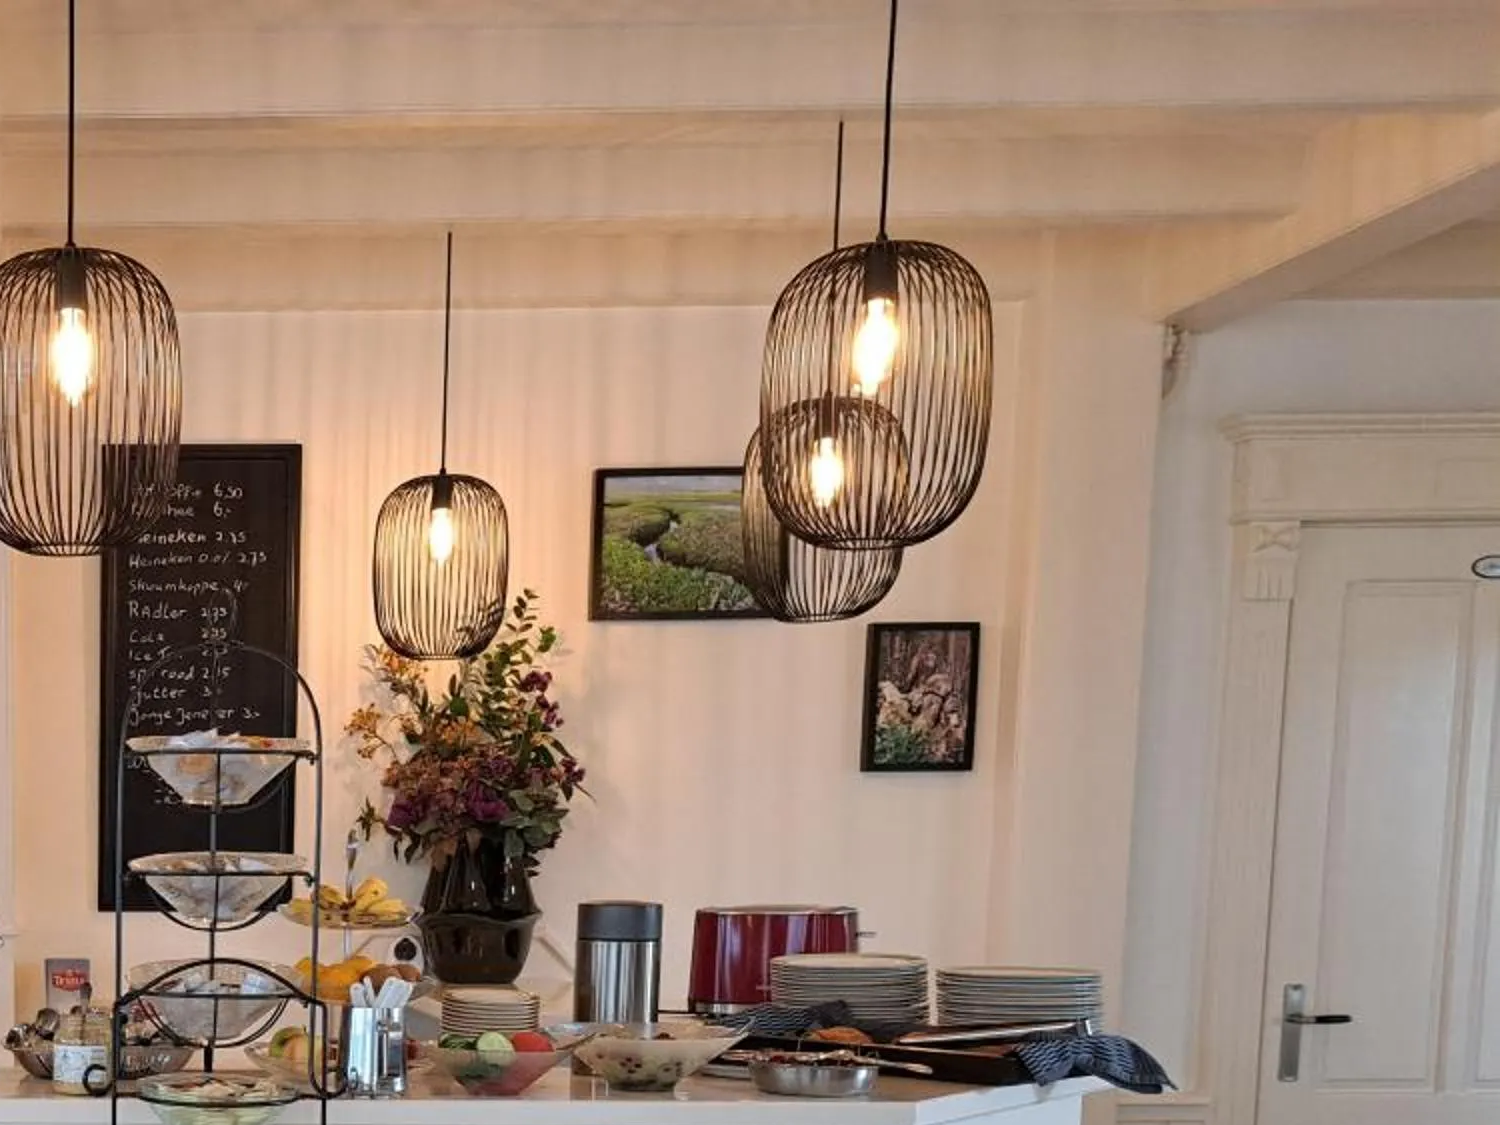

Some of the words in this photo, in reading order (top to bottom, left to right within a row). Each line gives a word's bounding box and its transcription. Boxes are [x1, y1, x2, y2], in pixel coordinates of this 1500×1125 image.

[135, 528, 208, 545] eineken
[128, 551, 194, 569] Heineken
[129, 628, 165, 644] Cola
[128, 667, 155, 685] sp
[160, 665, 196, 682] rood
[175, 706, 236, 726] Jeneer
